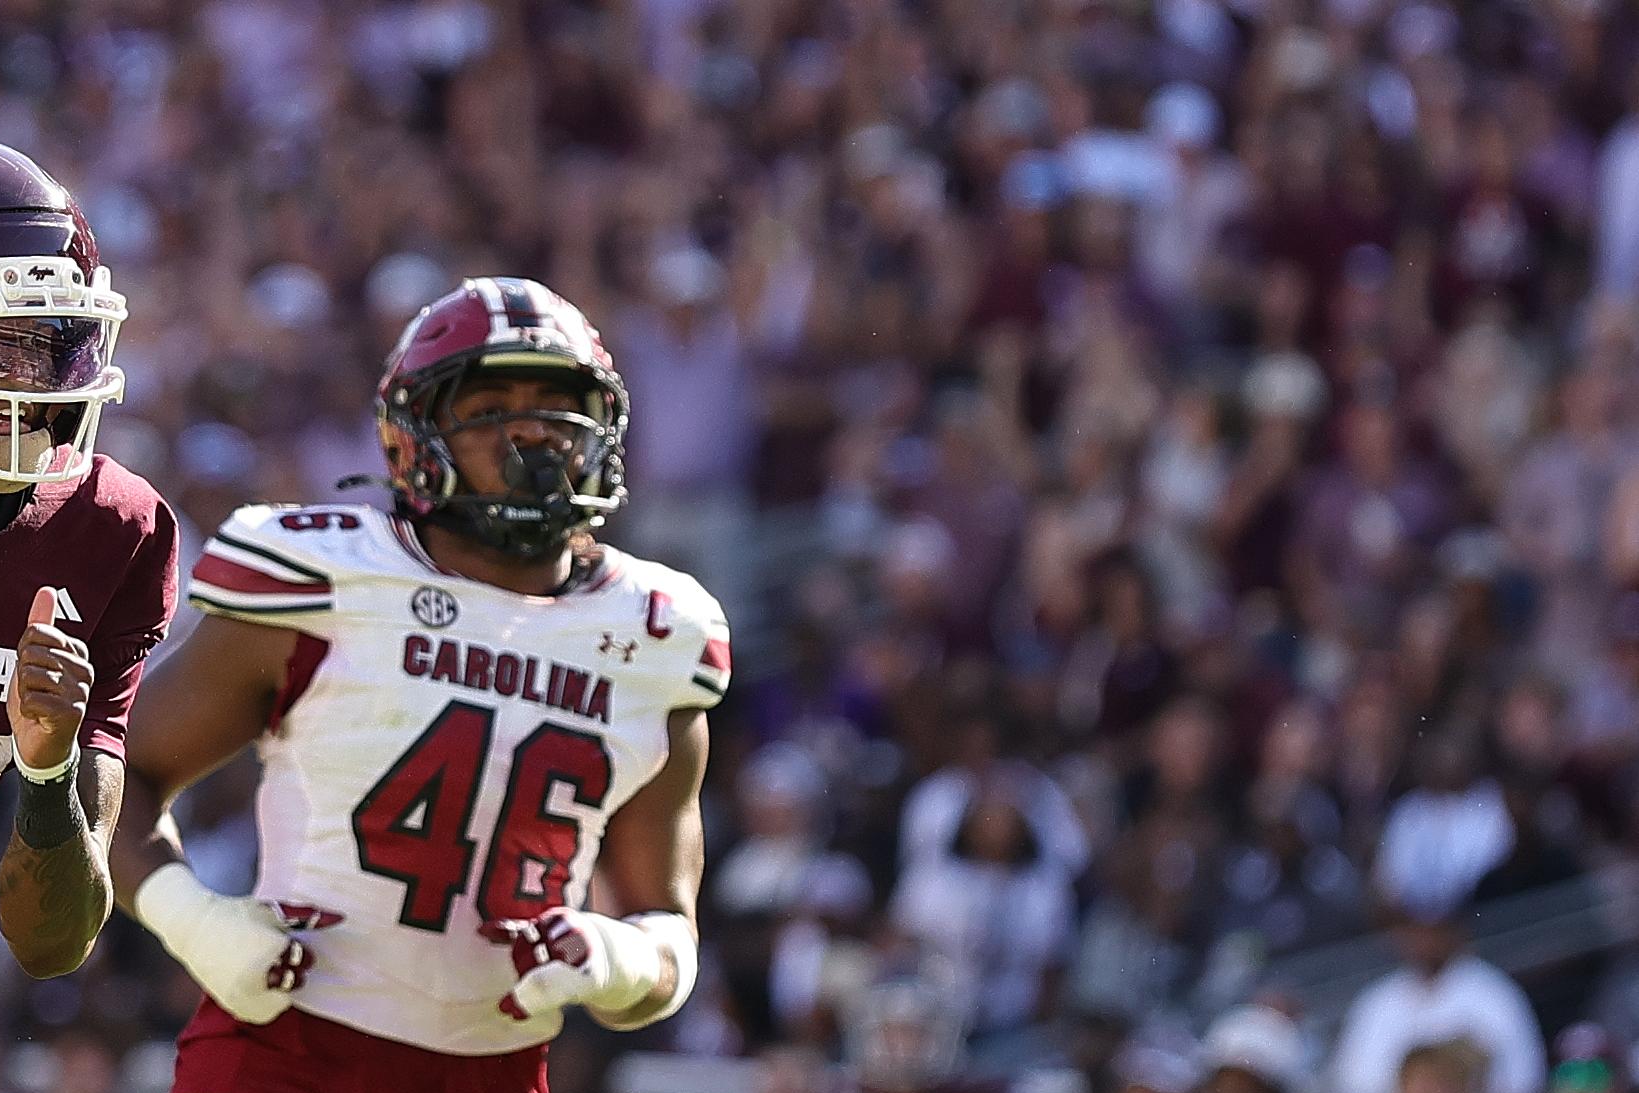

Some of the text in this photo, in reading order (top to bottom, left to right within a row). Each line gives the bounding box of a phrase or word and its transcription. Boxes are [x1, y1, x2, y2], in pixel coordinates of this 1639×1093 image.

[414, 586, 457, 626] SEC
[403, 634, 613, 723] CAROLINA
[351, 699, 611, 940] 46
